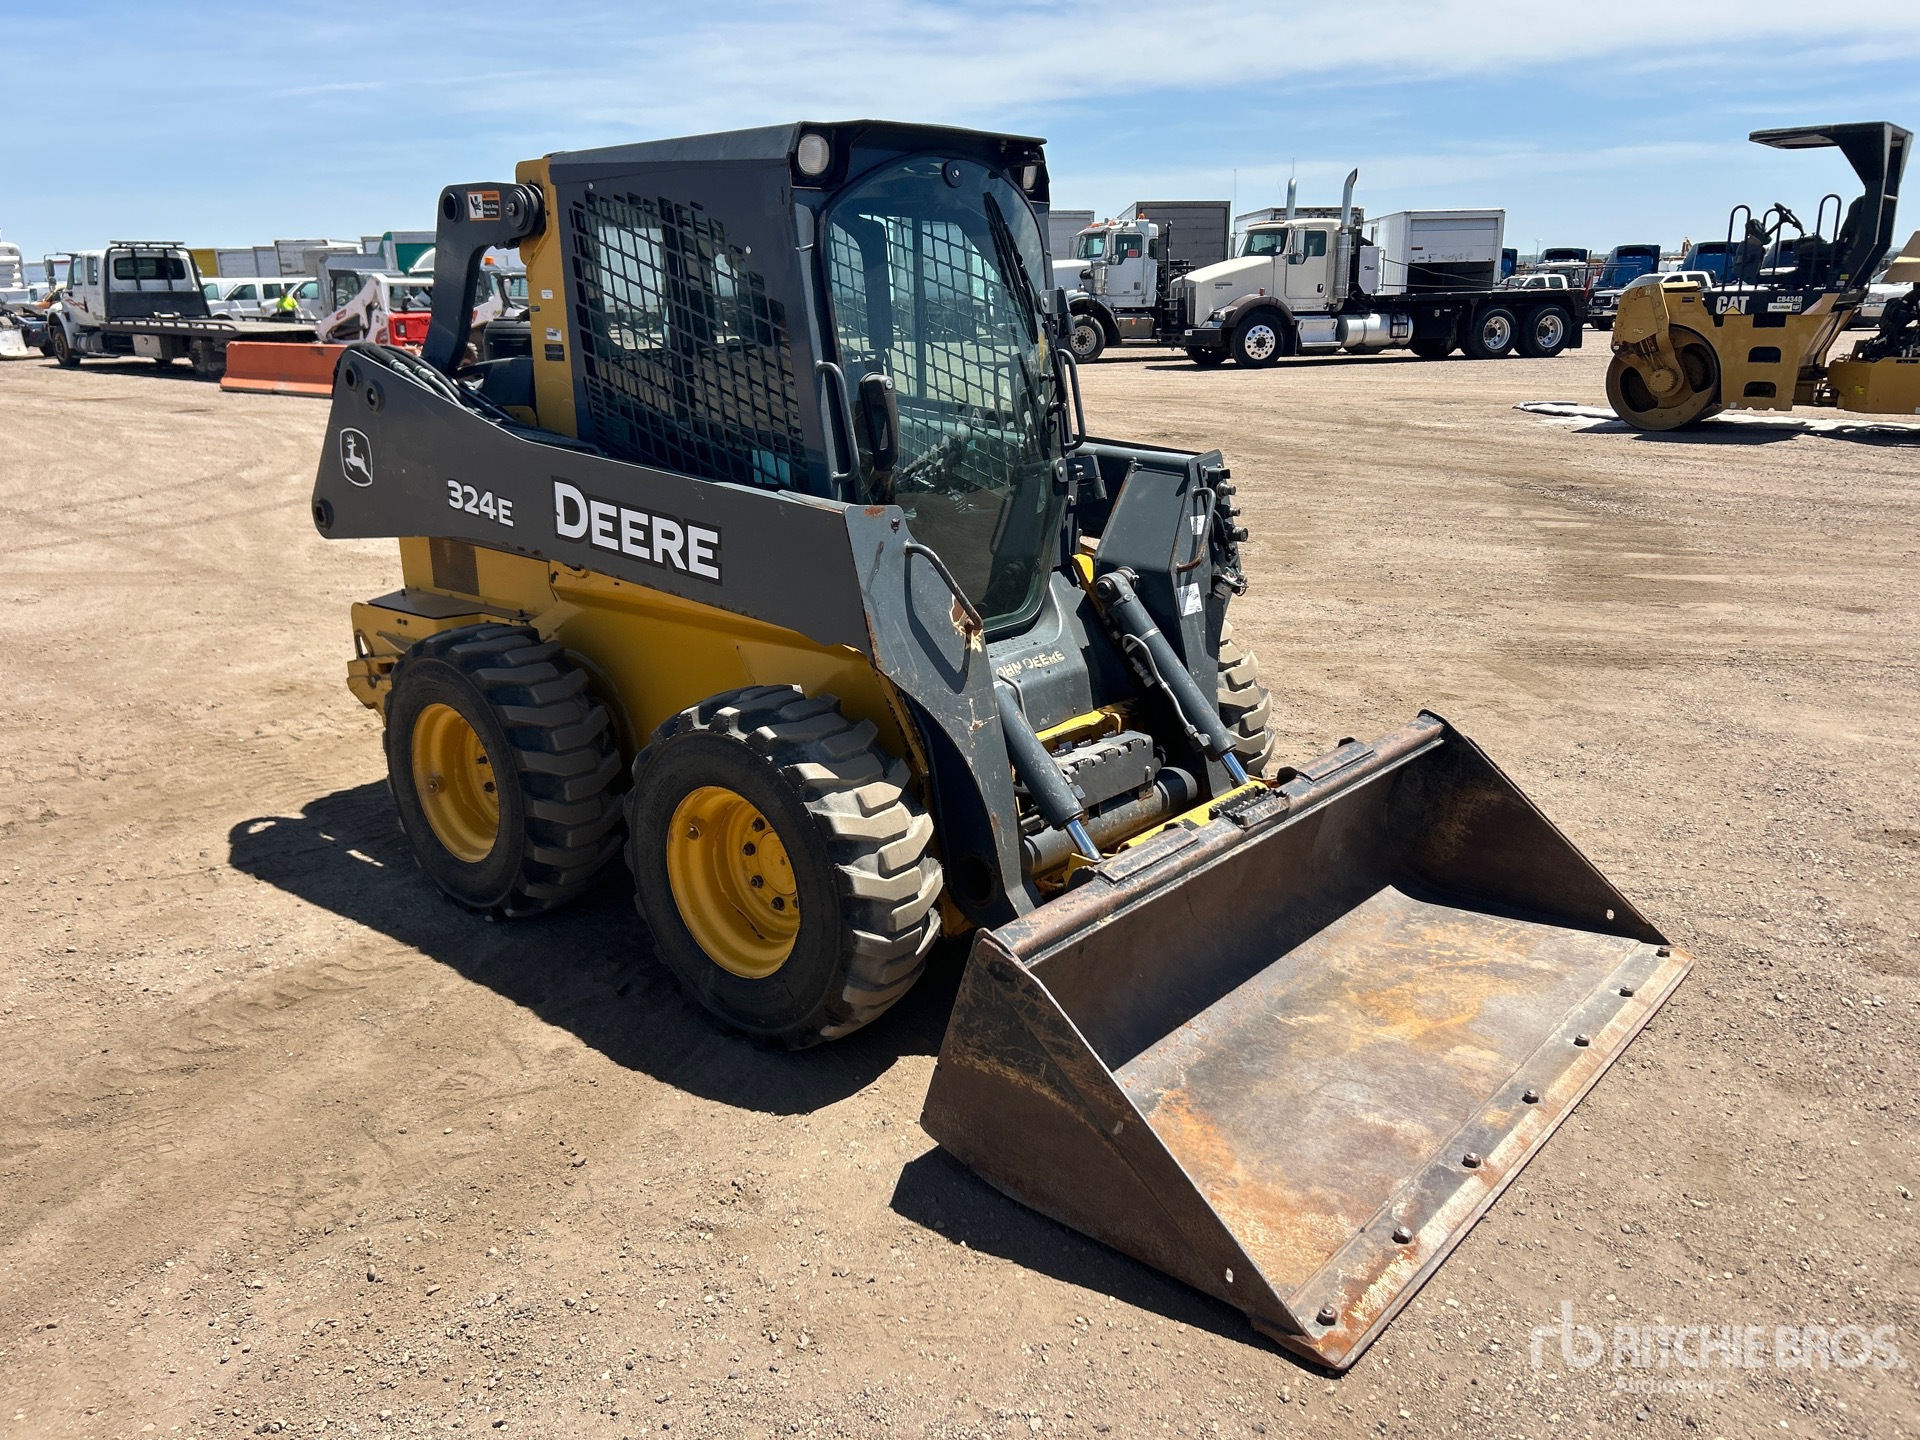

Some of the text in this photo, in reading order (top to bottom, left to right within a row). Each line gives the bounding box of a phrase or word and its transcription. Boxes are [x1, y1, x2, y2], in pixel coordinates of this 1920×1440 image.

[1715, 295, 1750, 315] CAT
[447, 479, 514, 527] 324E
[554, 480, 720, 580] DEERE
[995, 661, 1022, 677] OHN
